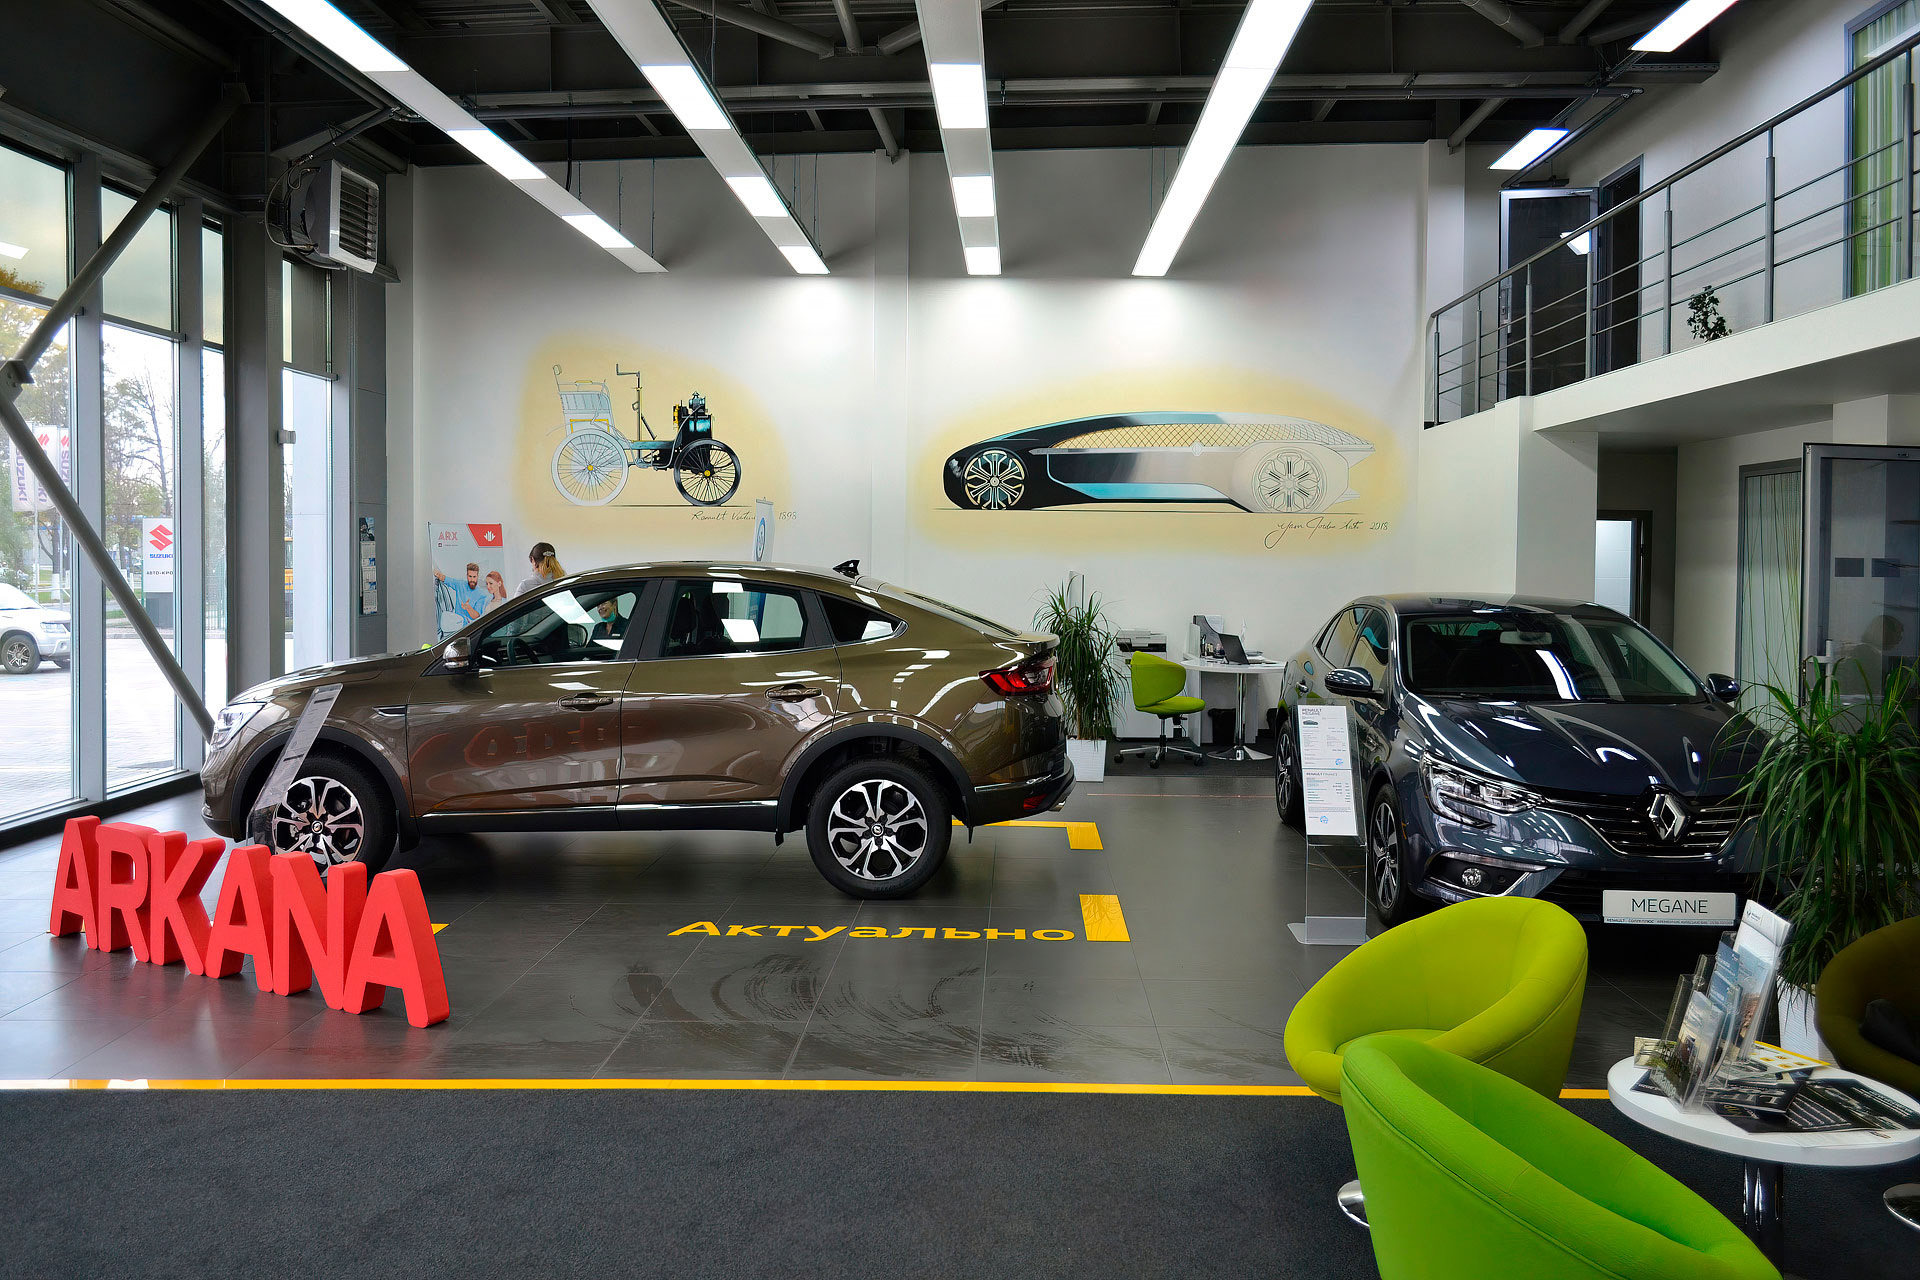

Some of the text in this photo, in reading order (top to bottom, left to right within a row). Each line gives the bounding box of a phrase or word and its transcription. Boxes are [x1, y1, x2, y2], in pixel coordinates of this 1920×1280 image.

[778, 511, 797, 521] 1898
[1369, 521, 1389, 531] 2018
[438, 531, 458, 541] ARX
[1631, 898, 1709, 914] MEGANE
[49, 815, 450, 1029] ARKANA
[667, 921, 1076, 942] Актуально
